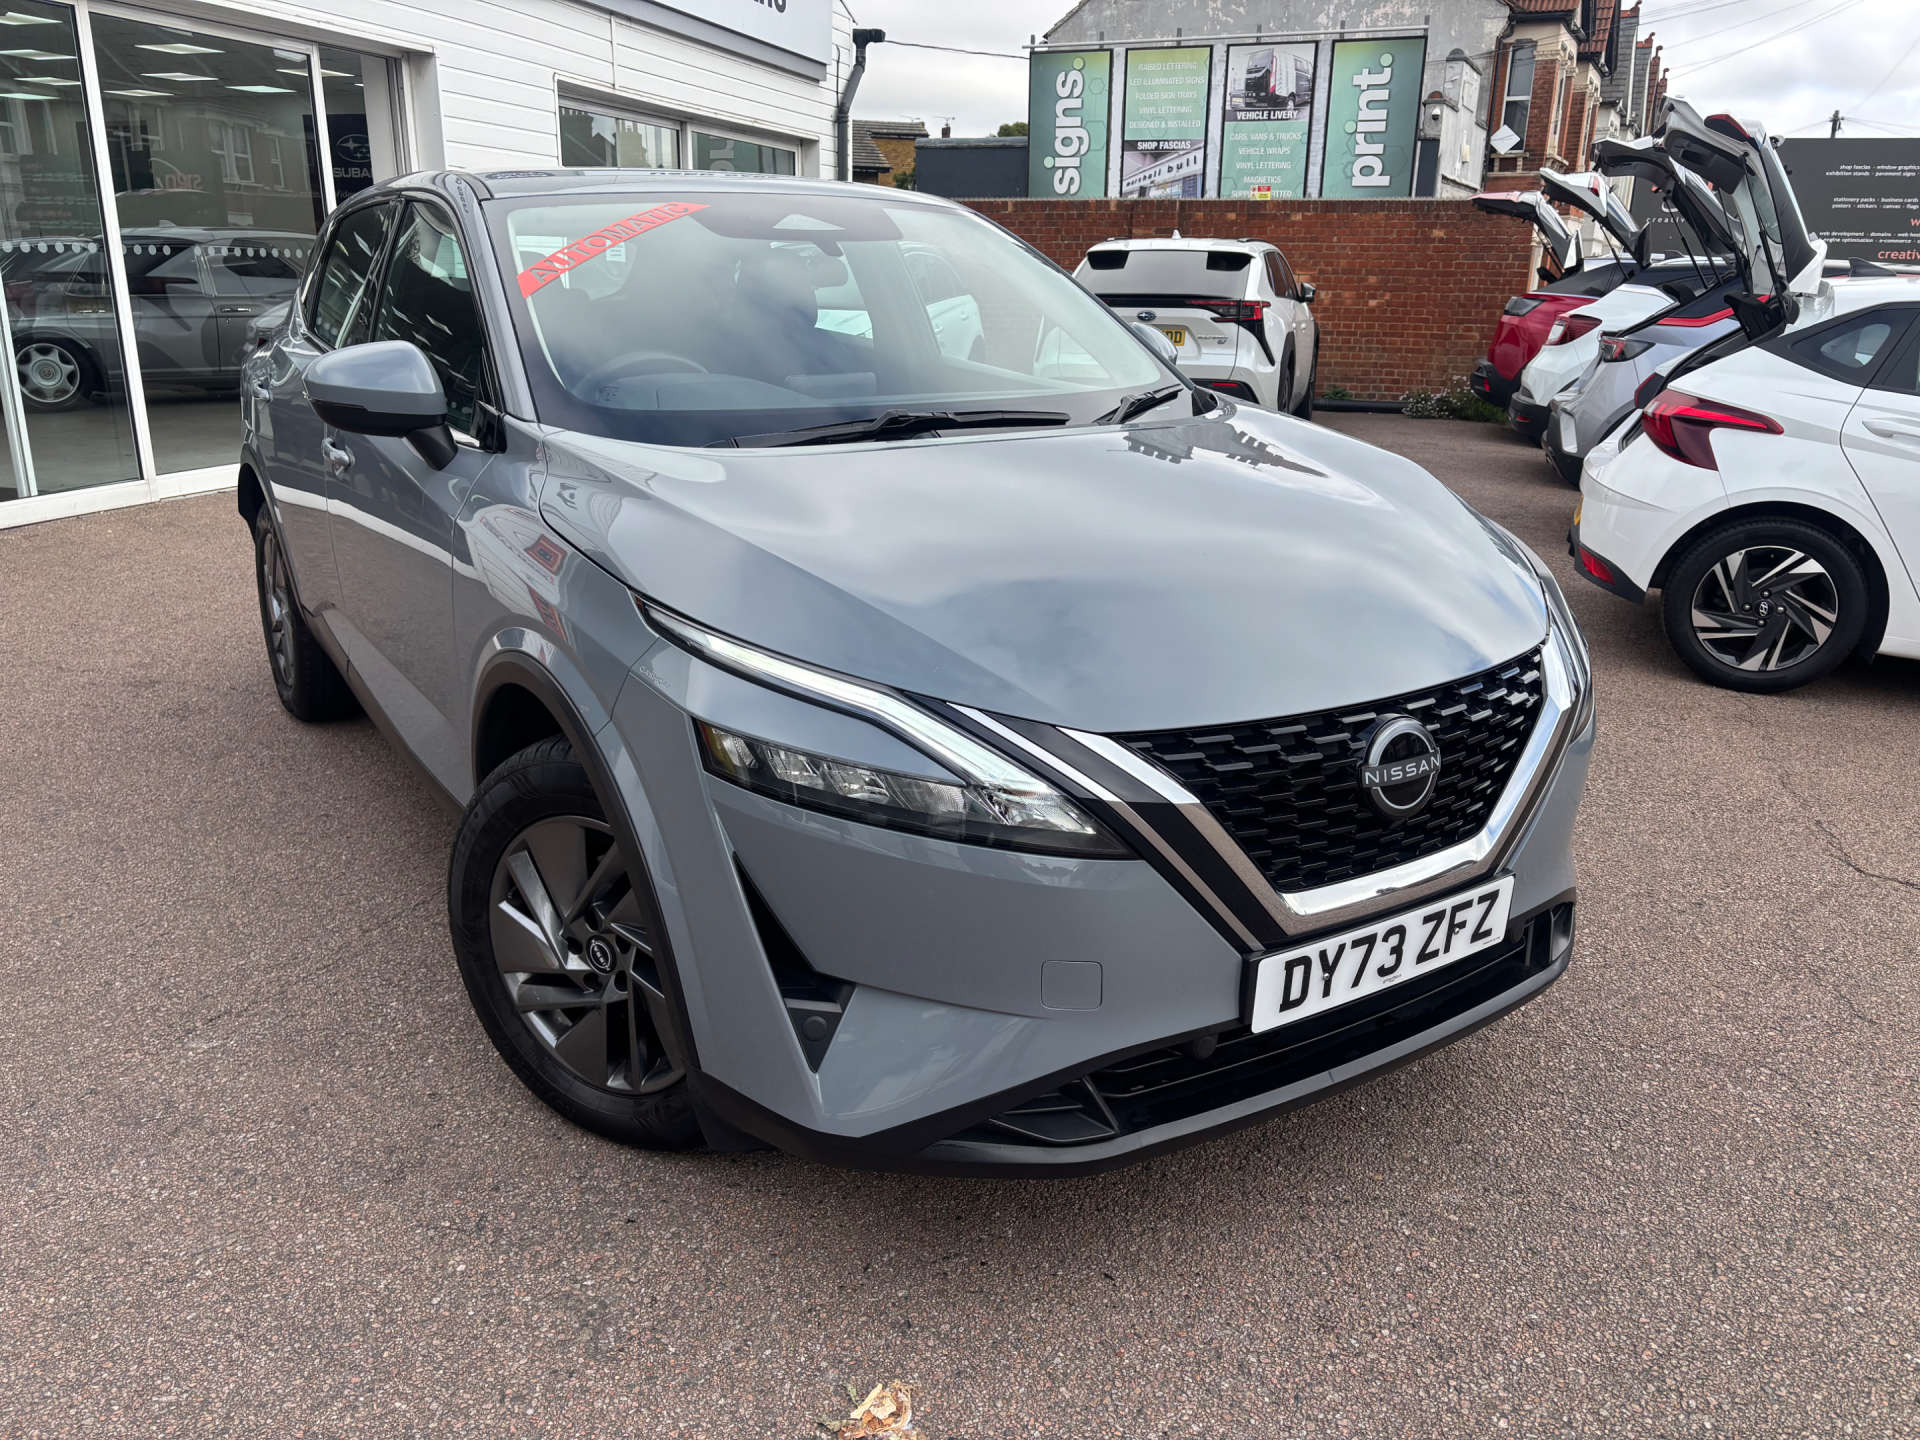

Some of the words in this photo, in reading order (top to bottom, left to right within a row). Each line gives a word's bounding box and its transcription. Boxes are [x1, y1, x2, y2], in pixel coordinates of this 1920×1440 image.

[1162, 62, 1197, 70] LETTERING
[1186, 75, 1205, 85] SIGNS
[1138, 106, 1157, 114] VINYL
[1158, 105, 1192, 113] LETTERING
[1236, 111, 1269, 120] VEHICLE
[1270, 110, 1298, 119] LIVERY
[1344, 53, 1393, 187] print.
[1043, 57, 1090, 195] signs.
[1129, 120, 1160, 129] DESIGNED
[1161, 120, 1166, 128] &
[1167, 119, 1201, 128] INSTALLED
[1276, 131, 1302, 140] TRUCKS
[1137, 141, 1158, 150] SHOP
[1159, 140, 1191, 150] FASCIAS
[1239, 147, 1264, 155] VEHICLE
[1266, 146, 1290, 154] WRAPS
[1236, 161, 1254, 169] VINYL
[1256, 161, 1292, 169] LETTERING
[333, 167, 373, 178] SUBA
[1243, 176, 1281, 184] MAGNETICS
[530, 203, 689, 283] AUTOMATIC
[1364, 756, 1440, 785] NISSAN
[1279, 924, 1407, 1013] DY73
[1416, 888, 1501, 966] ZFZ
